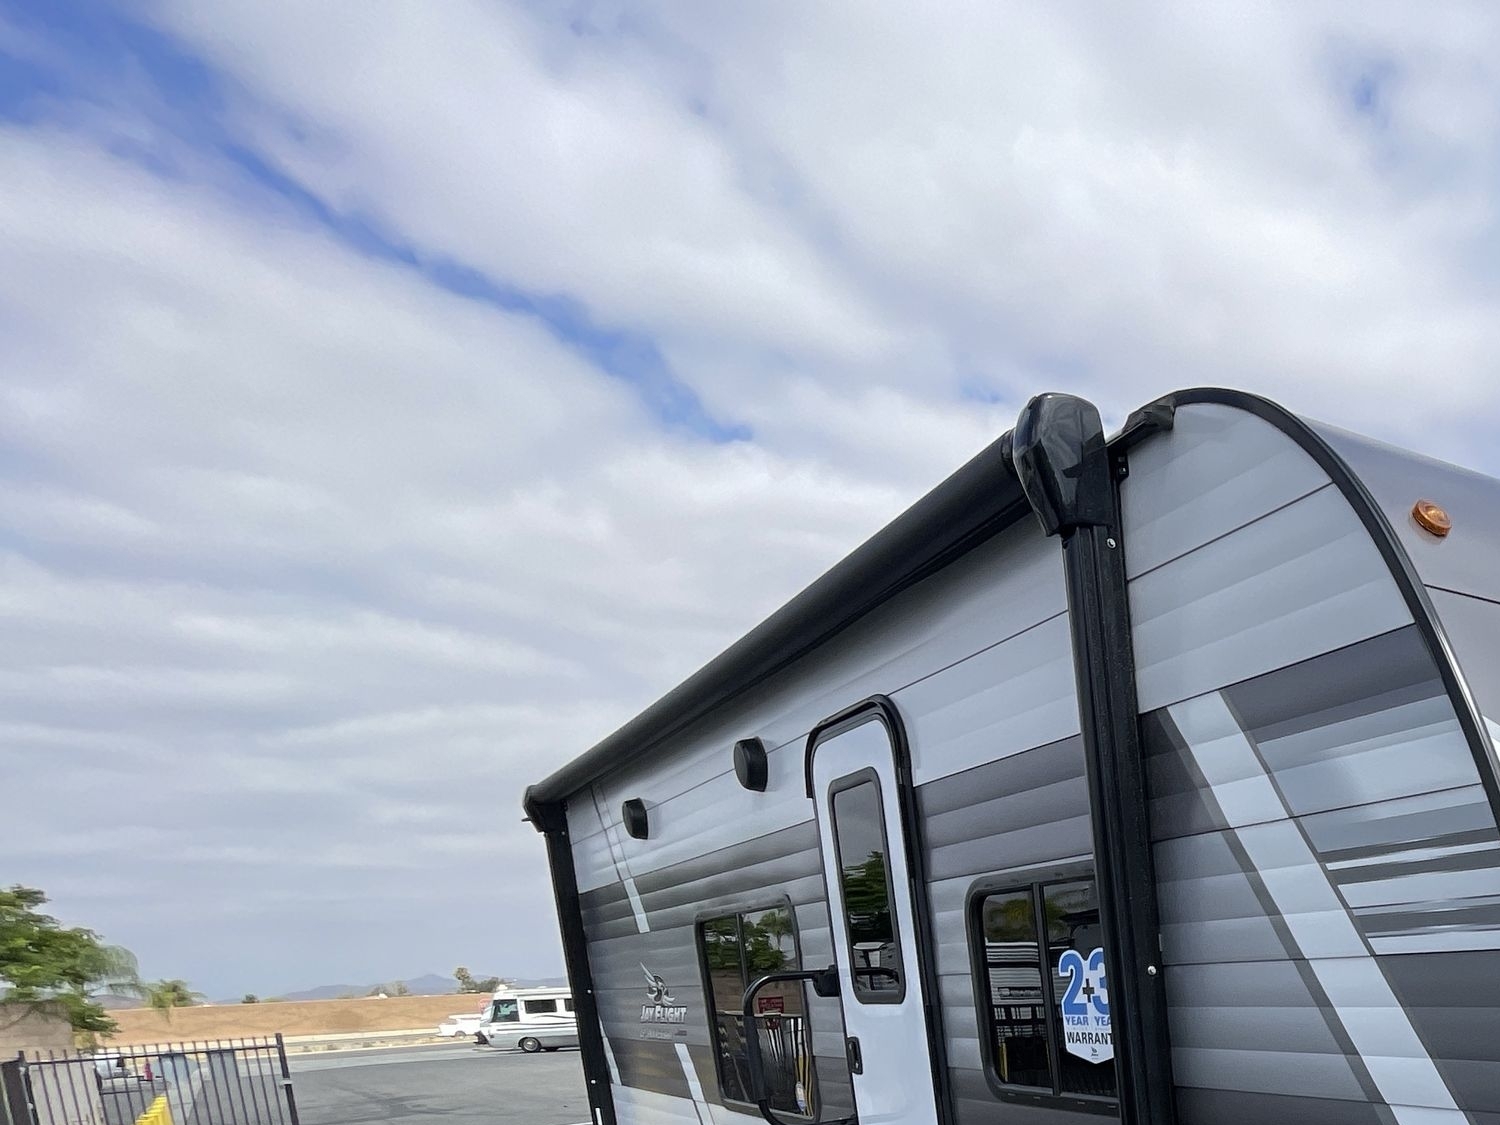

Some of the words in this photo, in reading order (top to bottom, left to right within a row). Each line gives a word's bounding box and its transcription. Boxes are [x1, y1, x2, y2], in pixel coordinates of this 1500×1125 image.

[655, 1005, 687, 1022] FLIGHT
[1065, 1016, 1089, 1026] YEAR
[1094, 1016, 1111, 1026] YEA
[1066, 1032, 1113, 1045] WARRANT
